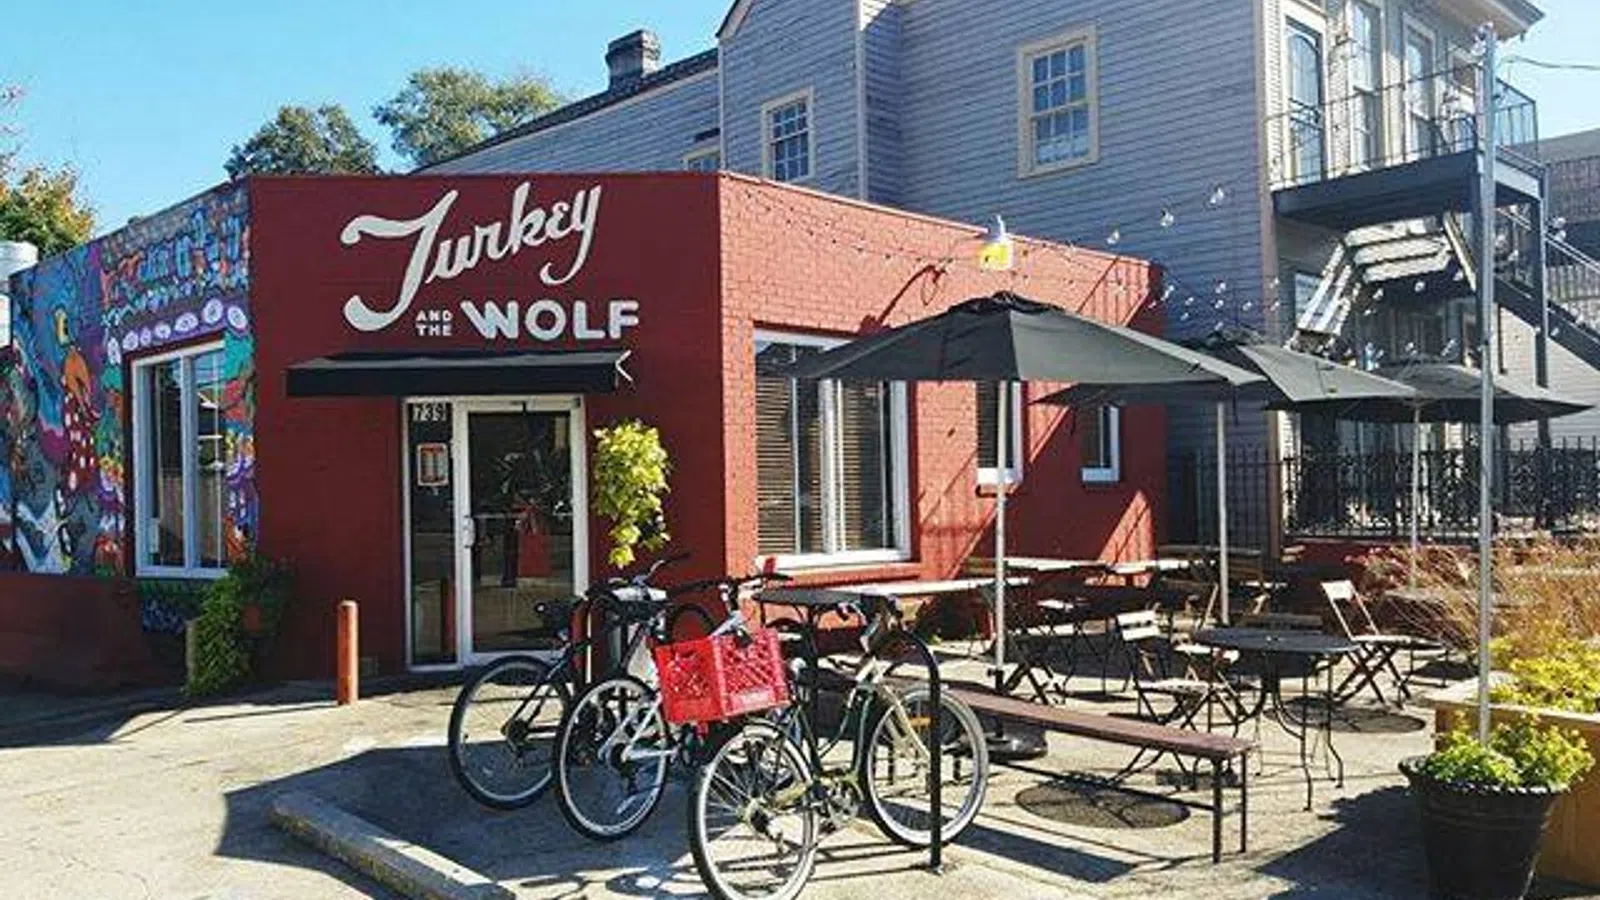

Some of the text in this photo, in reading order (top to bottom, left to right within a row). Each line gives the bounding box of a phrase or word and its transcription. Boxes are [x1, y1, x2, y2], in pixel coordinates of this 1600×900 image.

[340, 182, 602, 331] Turkey
[415, 310, 453, 322] AND
[460, 300, 639, 339] WOLF
[415, 323, 453, 337] THE
[412, 402, 447, 421] 739
